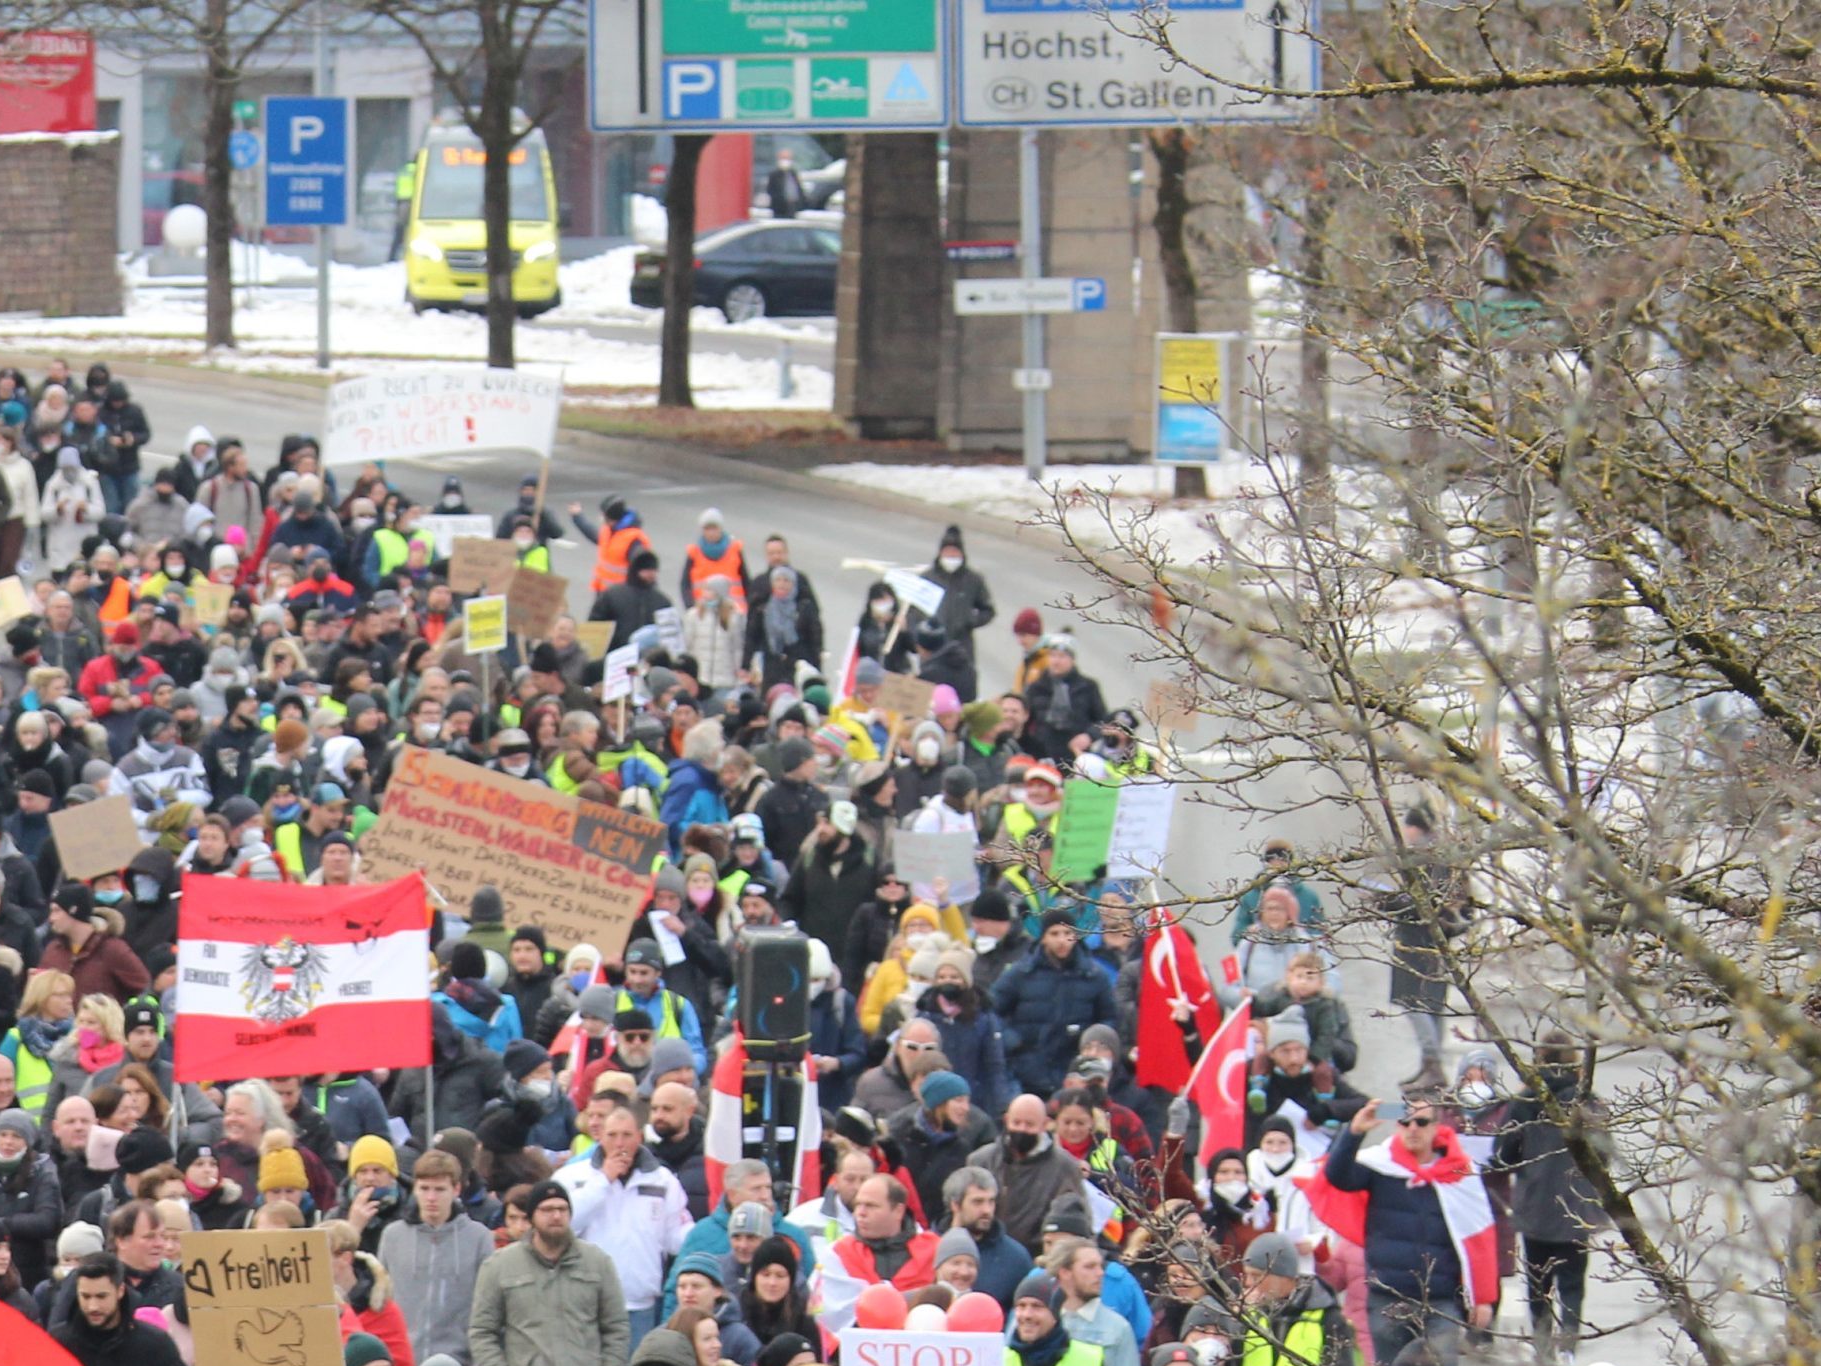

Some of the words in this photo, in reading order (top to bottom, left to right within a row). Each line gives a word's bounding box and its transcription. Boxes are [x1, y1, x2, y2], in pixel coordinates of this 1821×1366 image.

[982, 29, 1124, 64] Höchst,
[669, 64, 715, 117] P
[991, 84, 1028, 104] CH
[290, 115, 325, 155] P
[1079, 279, 1103, 310] P
[183, 967, 230, 988] DEMOKRATIE
[219, 1241, 313, 1291] Freiheit
